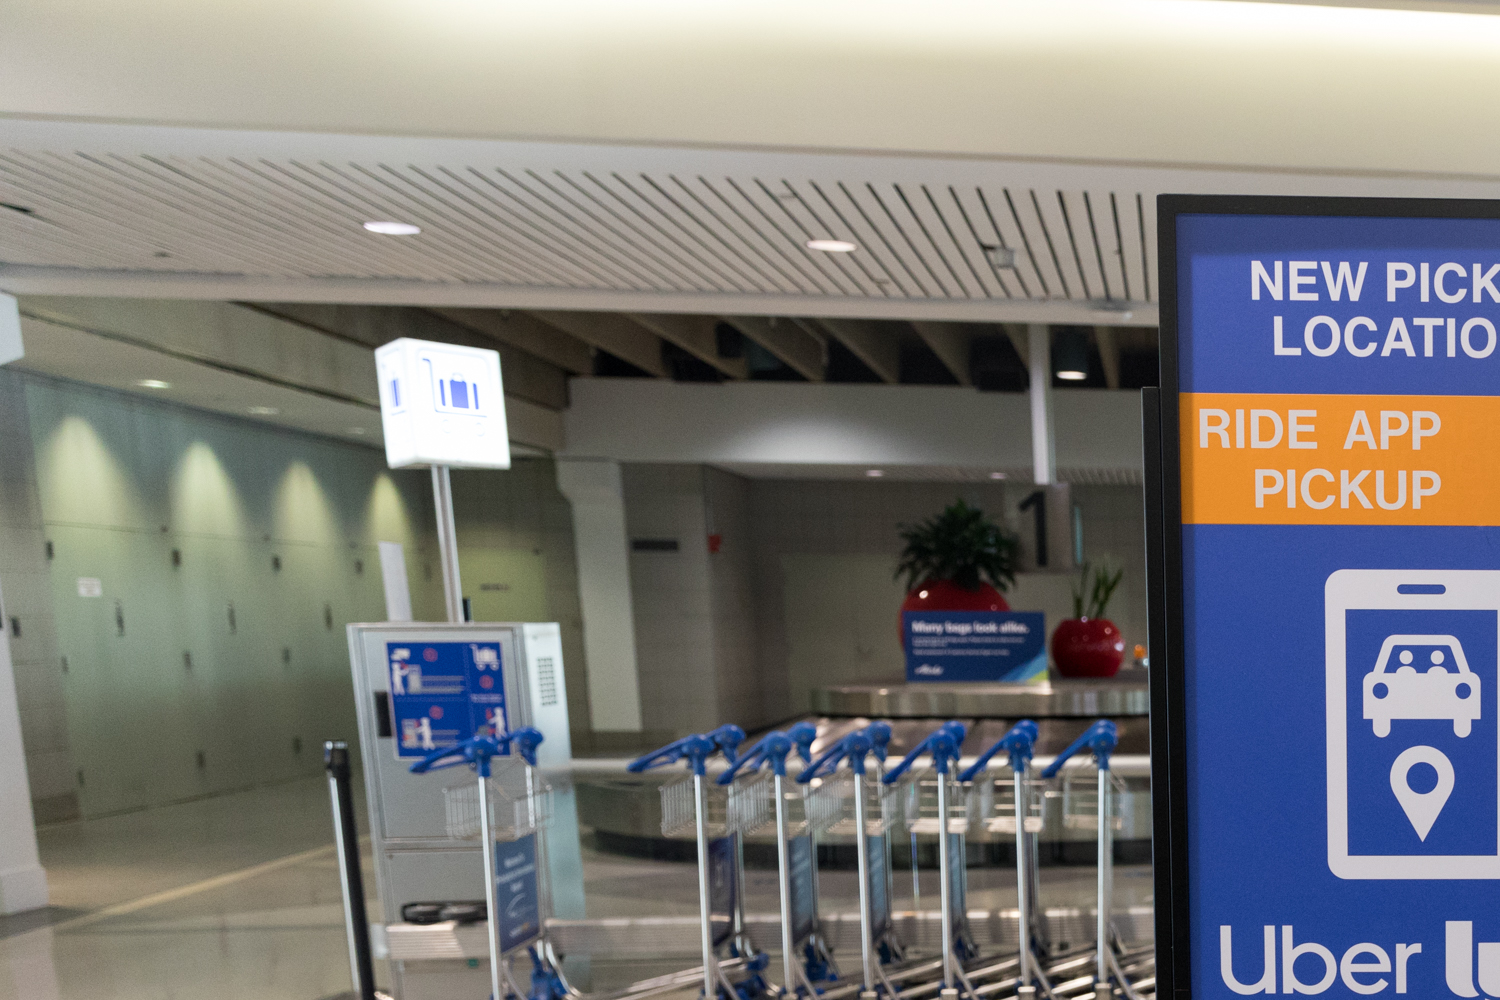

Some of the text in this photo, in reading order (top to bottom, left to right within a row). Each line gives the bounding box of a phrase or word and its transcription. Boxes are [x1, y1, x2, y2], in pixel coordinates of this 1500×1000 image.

[1251, 260, 1368, 301] NEW
[1199, 409, 1441, 450] RIDE APP
[1254, 468, 1442, 510] PICKUP
[1018, 490, 1048, 567] 1
[911, 620, 944, 636] Many
[945, 620, 973, 636] bags
[973, 620, 999, 634] look
[1220, 925, 1422, 995] Uber
